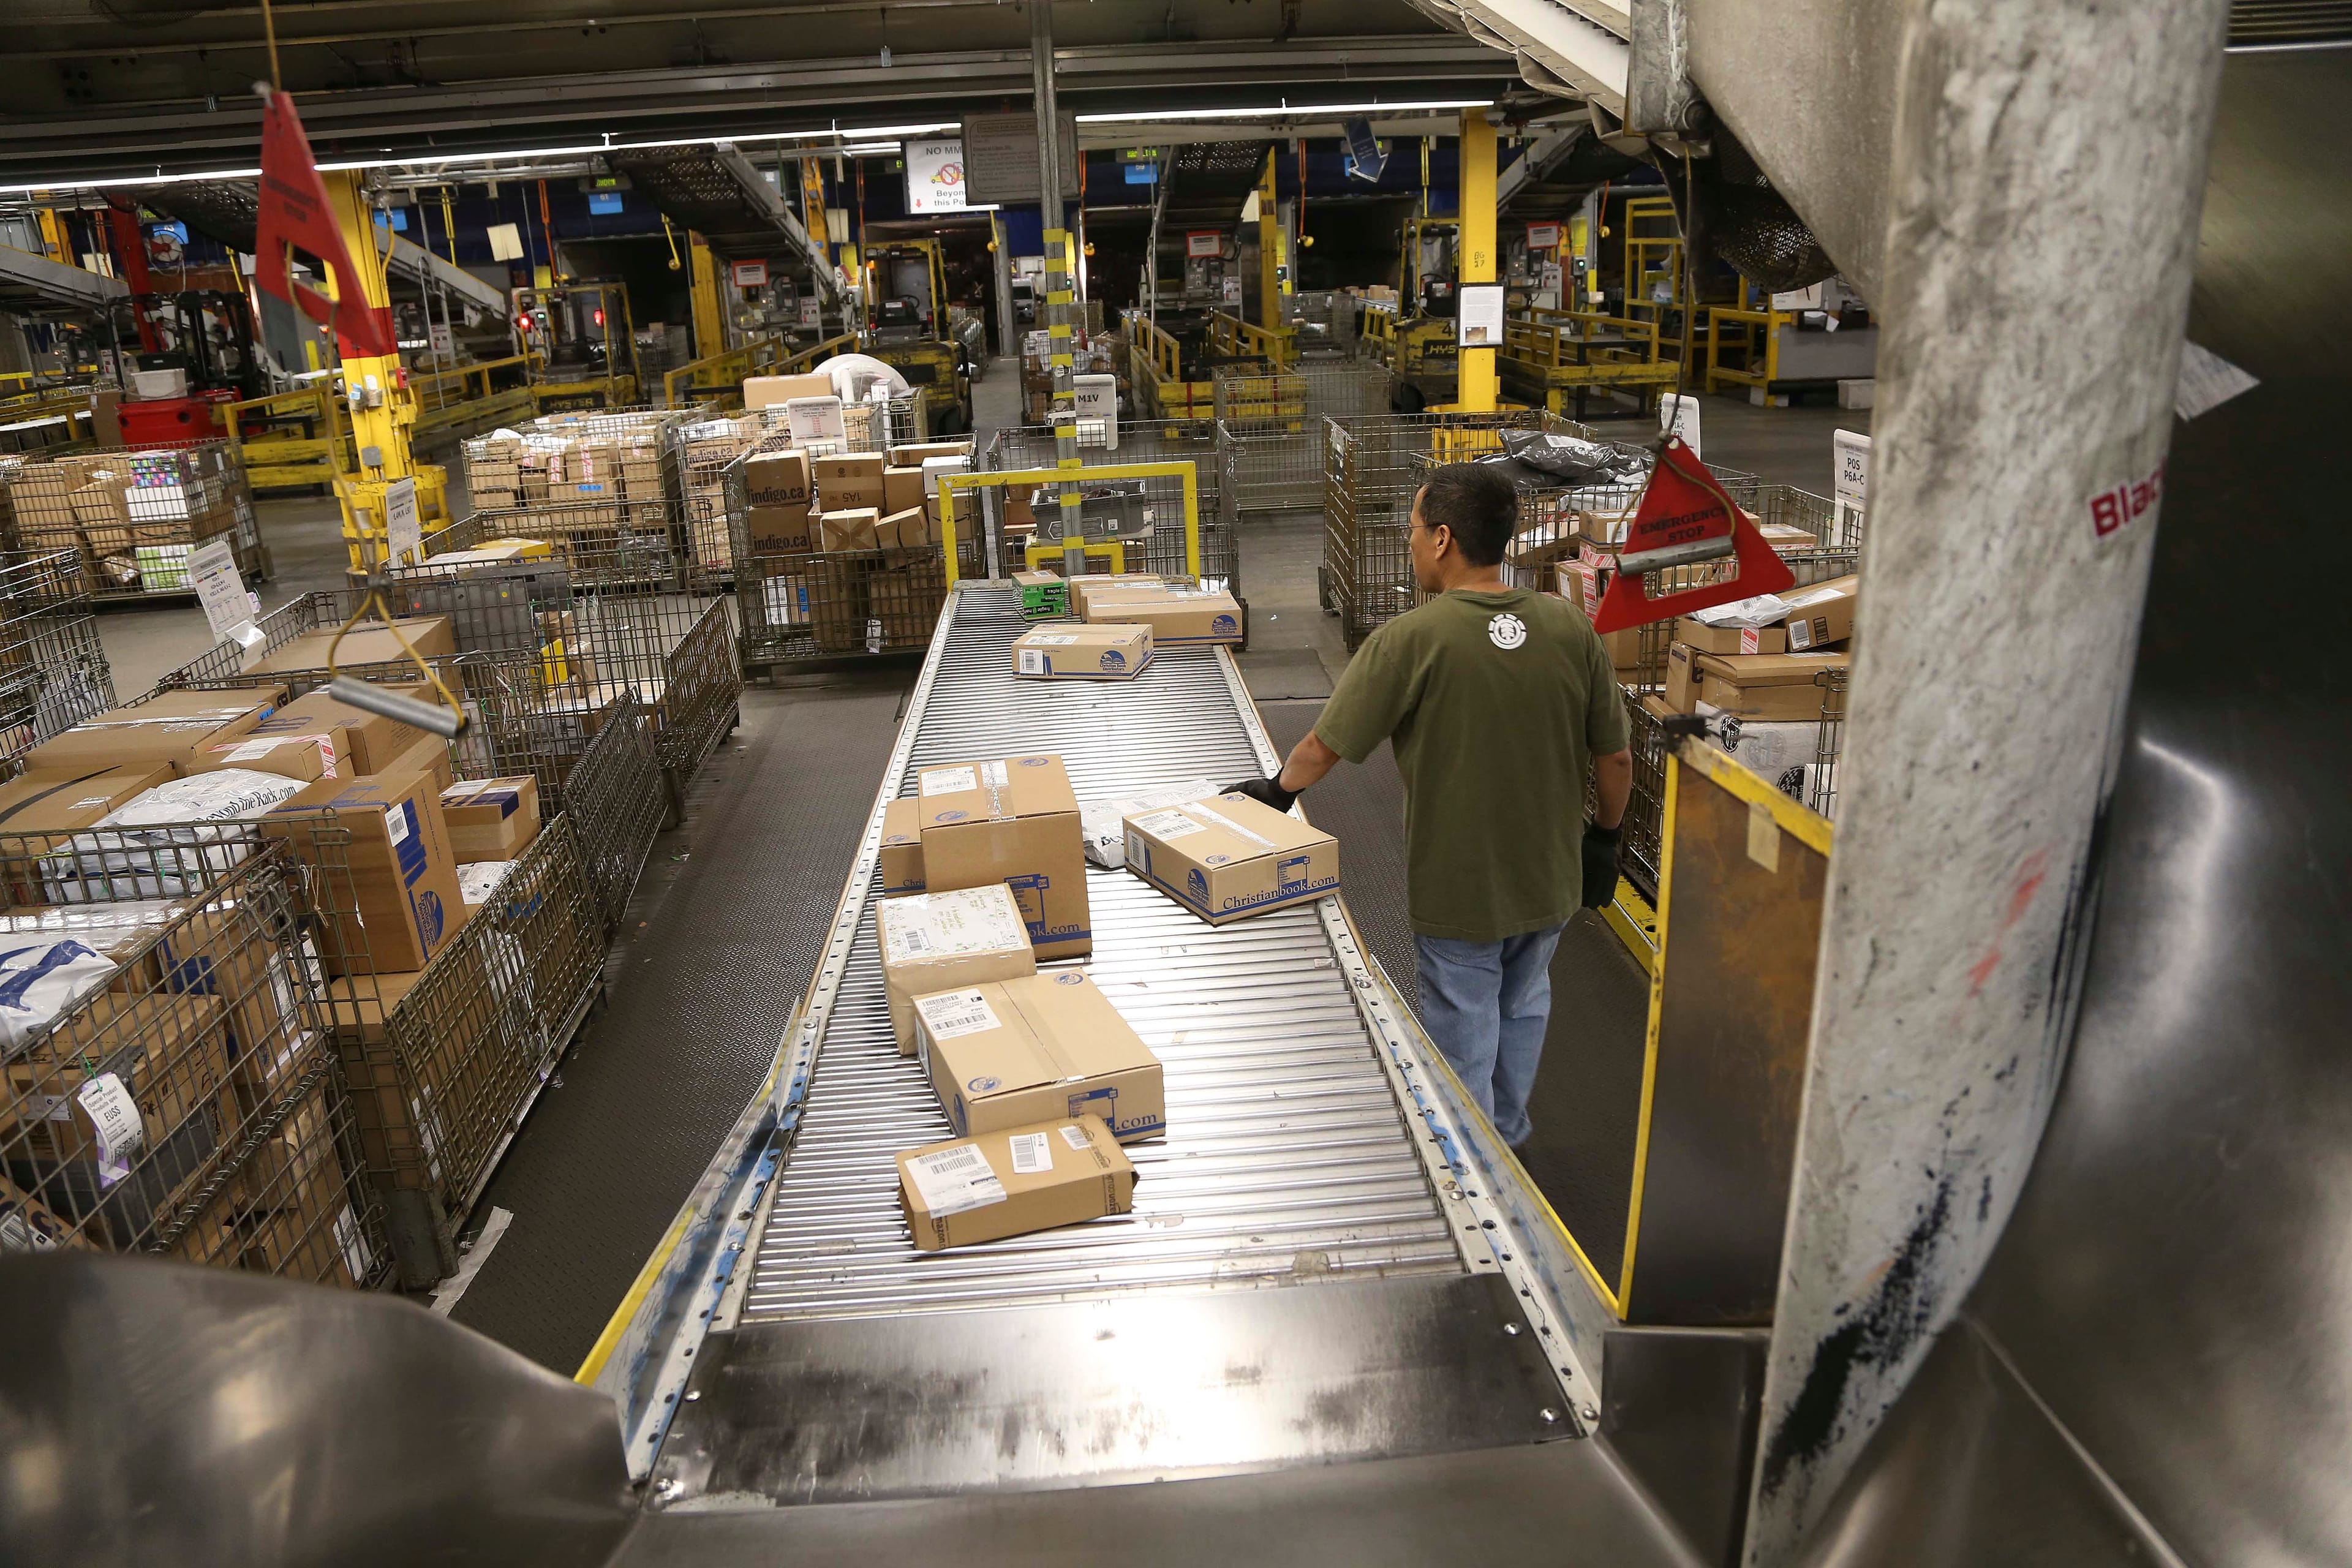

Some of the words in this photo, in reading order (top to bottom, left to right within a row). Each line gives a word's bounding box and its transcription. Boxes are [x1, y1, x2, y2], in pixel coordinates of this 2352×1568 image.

[1428, 344, 1456, 355] HYS
[1078, 394, 1099, 402] M1V
[687, 446, 733, 464] indigo.ca
[1844, 470, 1864, 485] P6A-C
[751, 486, 805, 504] indigo.ca
[842, 492, 862, 502] 1A5
[753, 533, 807, 551] indigo.ca
[1668, 525, 1705, 542] STOP
[252, 785, 297, 807] Rack.com
[903, 878, 925, 888] Chris
[1223, 875, 1335, 910] Christianbook.com
[1029, 922, 1080, 937] ok.com
[104, 1105, 122, 1122] EUSS
[1114, 1113, 1158, 1131] .com
